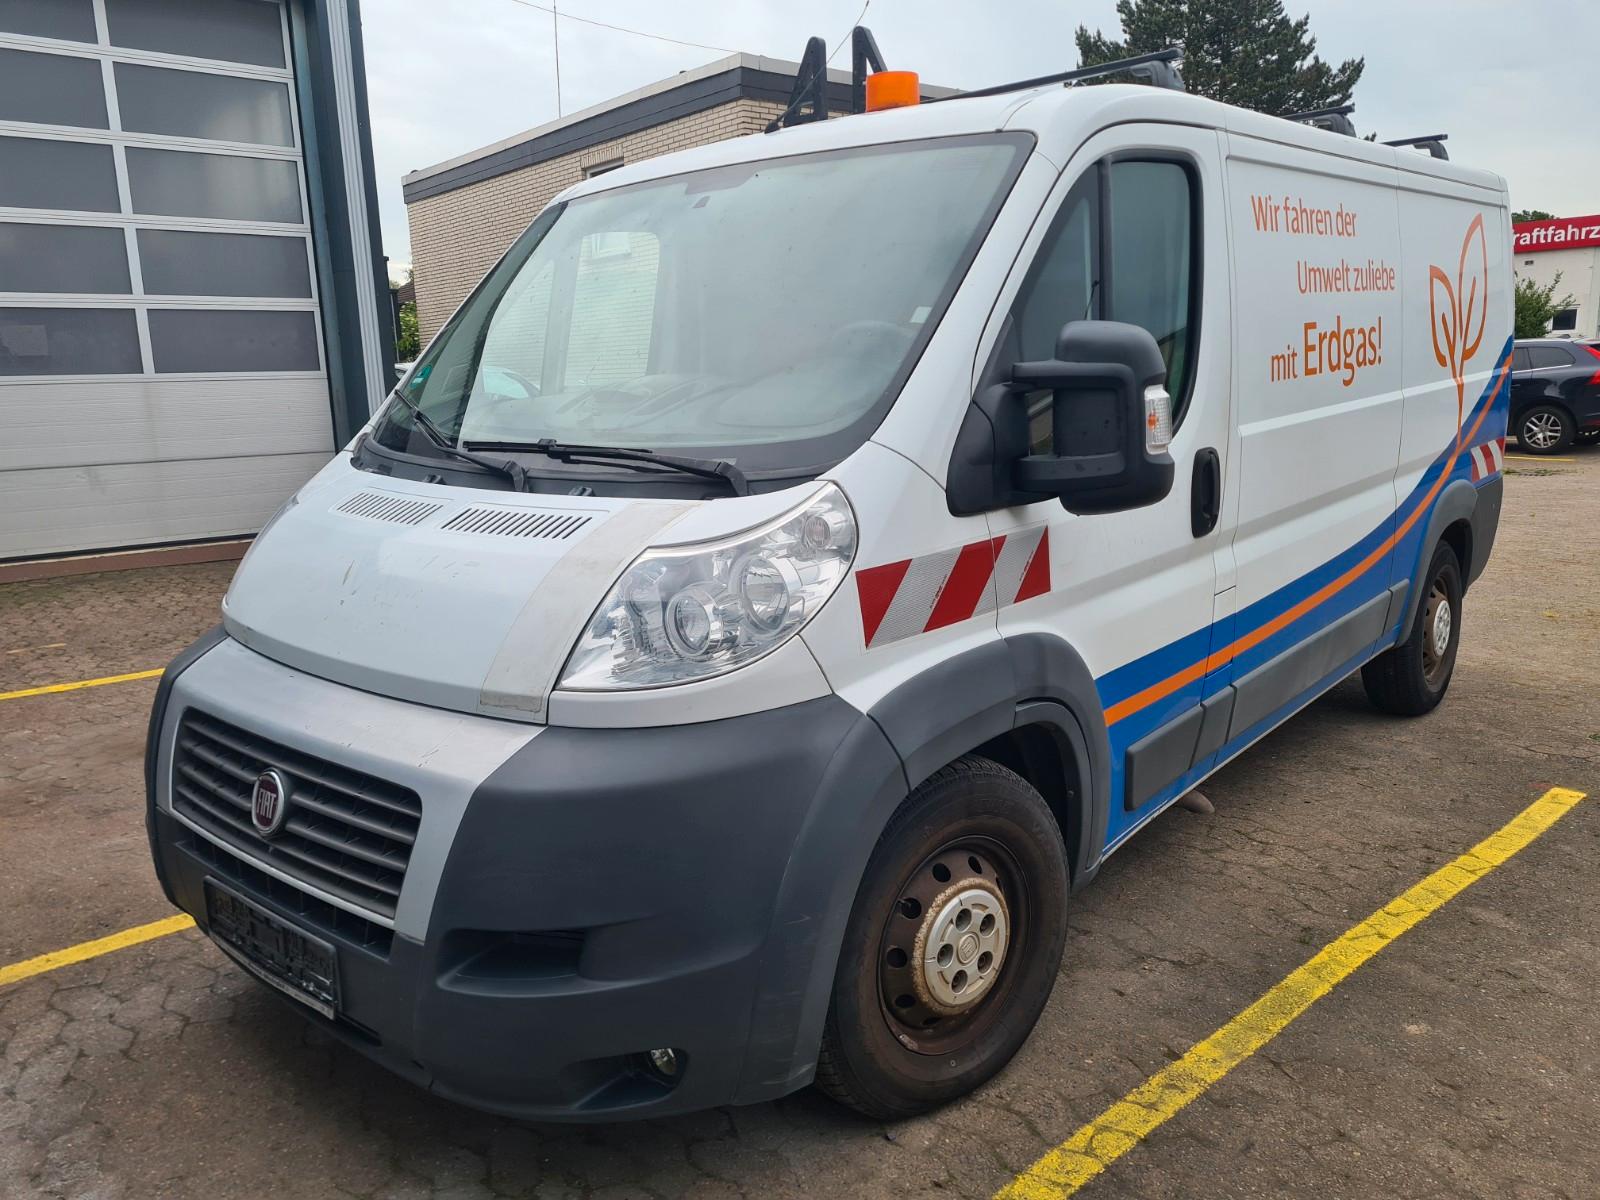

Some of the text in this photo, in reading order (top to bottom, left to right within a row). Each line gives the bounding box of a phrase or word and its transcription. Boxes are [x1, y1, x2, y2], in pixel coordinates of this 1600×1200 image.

[1251, 194, 1357, 237] Wir fahren der
[1512, 224, 1600, 247] raftfahrz
[1297, 258, 1395, 294] Umwelt zuliebe
[1271, 315, 1382, 387] mit Erdgas!
[256, 787, 277, 819] FIAT
